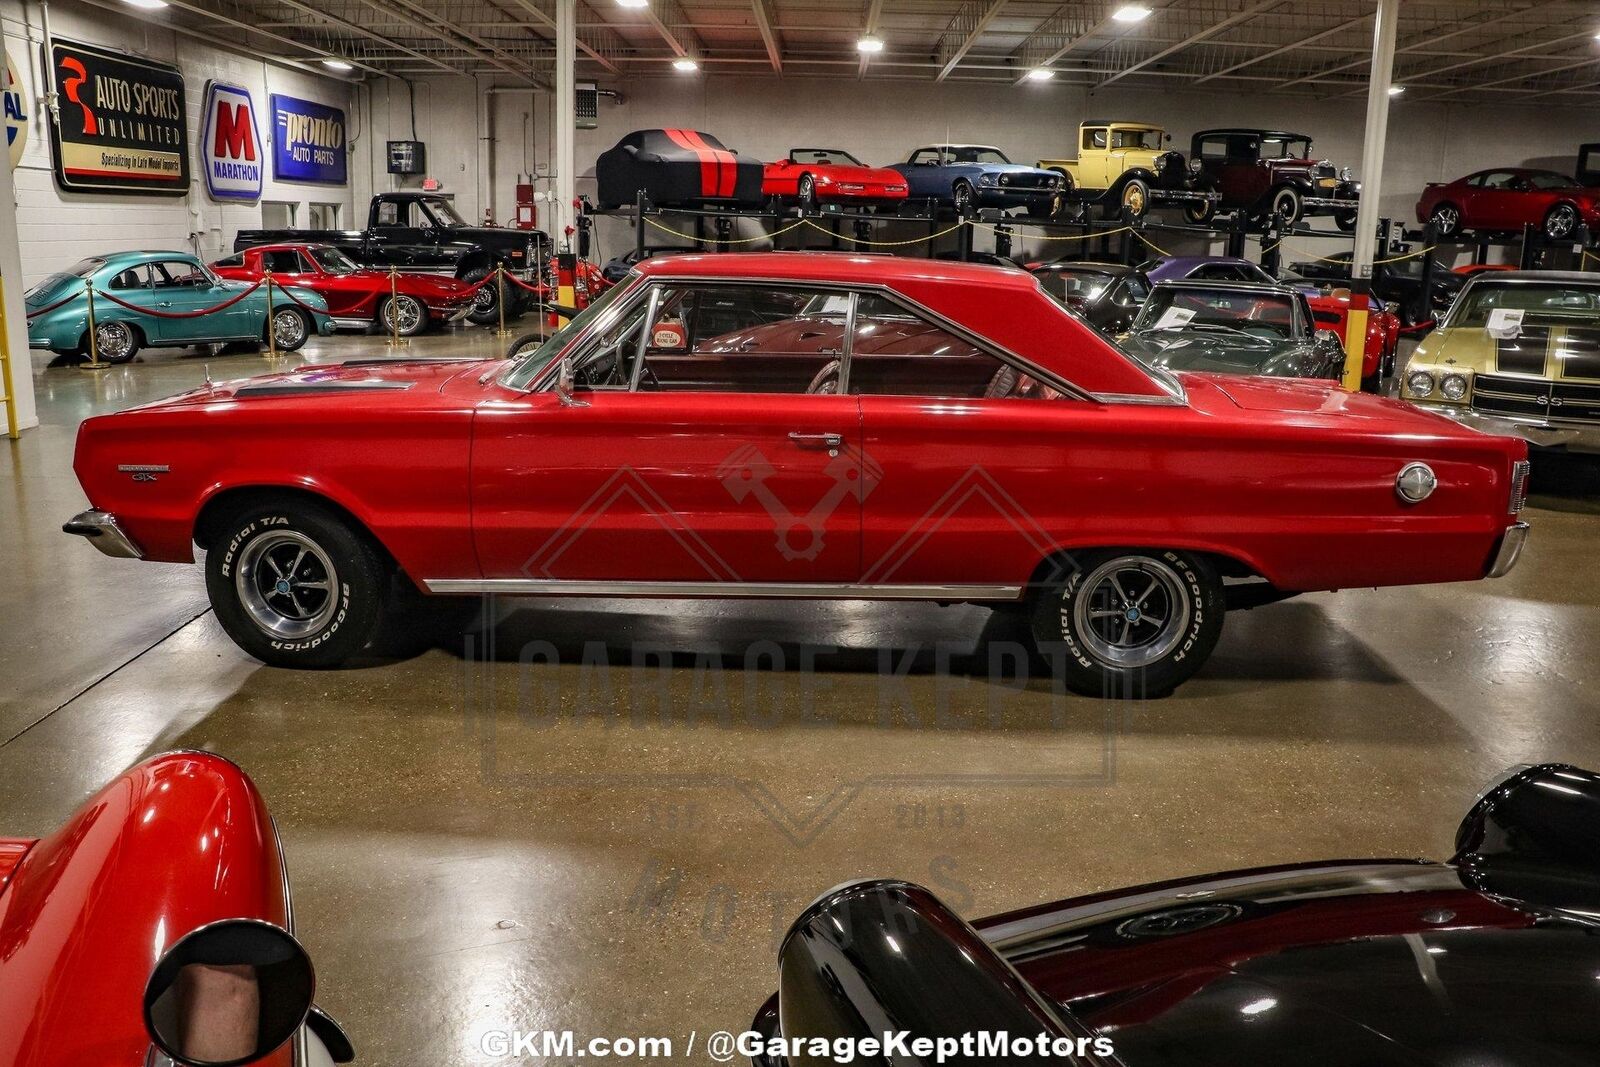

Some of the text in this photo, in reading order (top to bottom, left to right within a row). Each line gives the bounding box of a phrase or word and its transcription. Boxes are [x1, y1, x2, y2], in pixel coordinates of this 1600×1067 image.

[96, 74, 180, 121] AUTO SPORTS
[98, 117, 181, 146] UNLIMITED
[214, 101, 256, 161] M
[286, 112, 342, 150] pronto
[101, 152, 131, 169] Specializing
[138, 156, 148, 169] Late
[148, 157, 162, 170] Model
[162, 158, 179, 173] Imports
[214, 162, 259, 182] MARATHON
[292, 145, 335, 166] AUTO PARTS
[1536, 395, 1563, 407] SS
[222, 516, 290, 578] Radial T/A
[270, 582, 351, 653] BFGoodrich
[1060, 572, 1092, 668] Radial T/A
[1163, 551, 1203, 663] BFGoodrich
